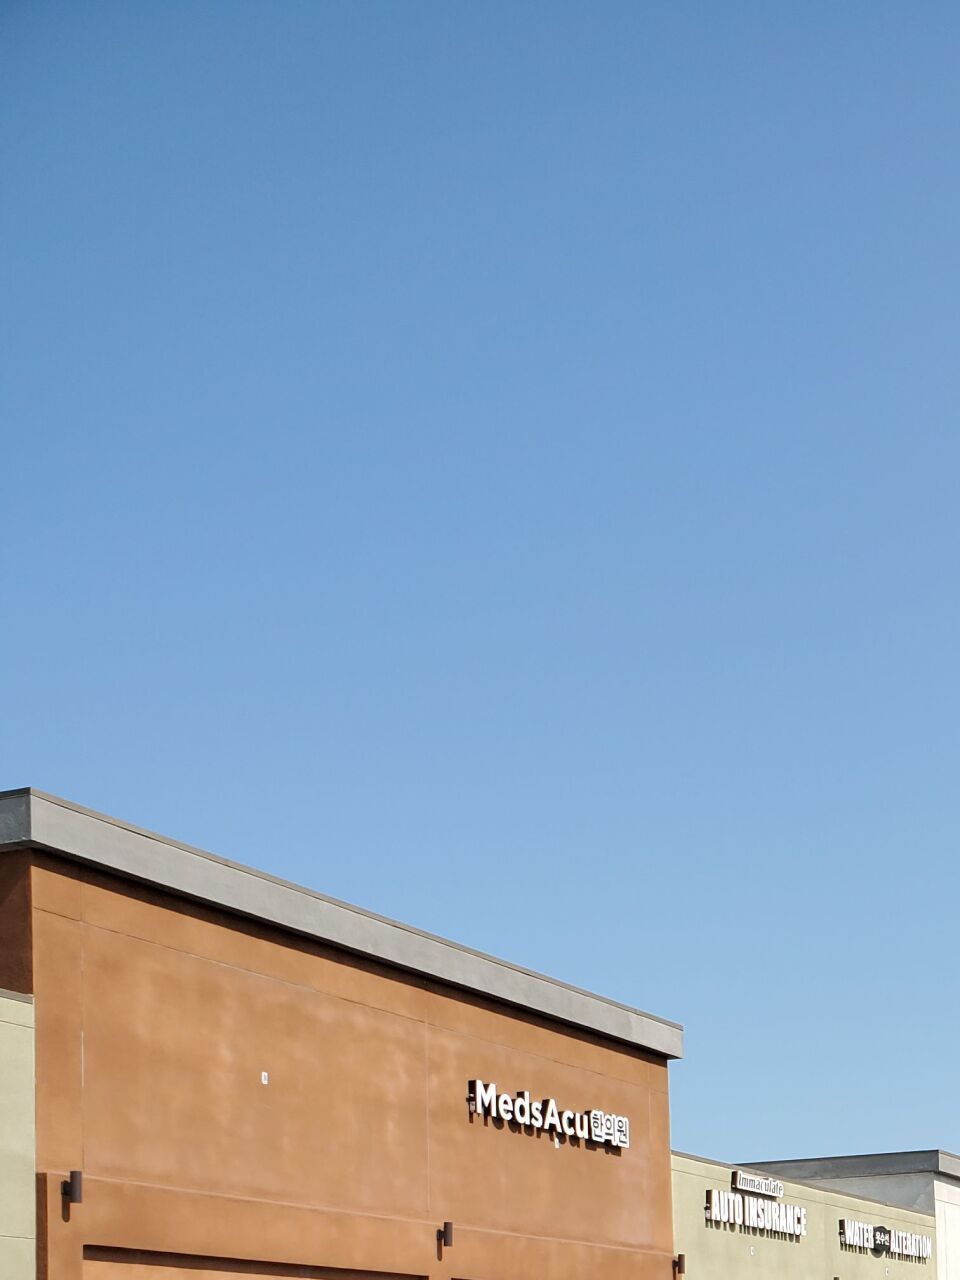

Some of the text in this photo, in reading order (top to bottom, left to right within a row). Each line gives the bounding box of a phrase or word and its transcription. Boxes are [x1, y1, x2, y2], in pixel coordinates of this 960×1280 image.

[475, 1079, 629, 1148] MedsAcu 한의원
[738, 1172, 783, 1196] Immaculate
[711, 1188, 807, 1236] AUTO INSURANCE
[845, 1219, 874, 1249] WATER
[890, 1229, 932, 1259] ALTERATION
